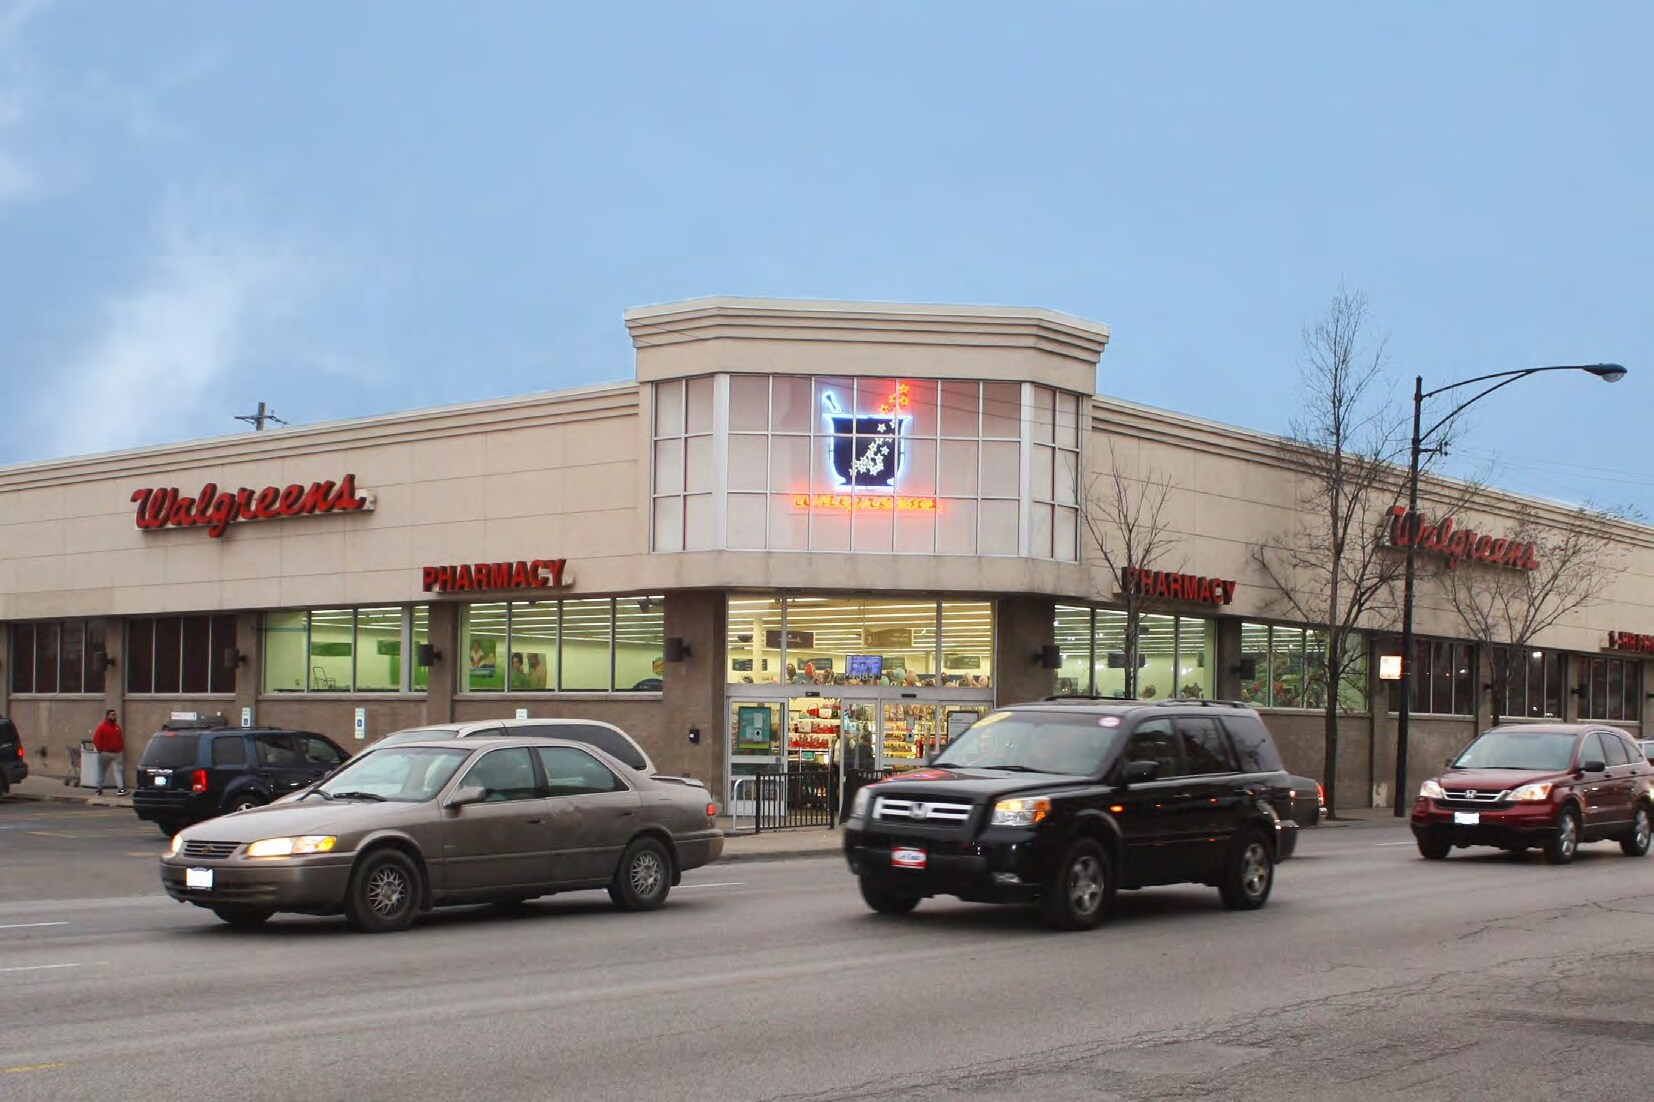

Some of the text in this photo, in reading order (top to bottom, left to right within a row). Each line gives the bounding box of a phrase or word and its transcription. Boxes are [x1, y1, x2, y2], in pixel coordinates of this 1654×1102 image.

[130, 473, 367, 538] Walgreens
[1385, 505, 1540, 570] Walgreens
[422, 558, 567, 592] PHARMACY
[1121, 566, 1237, 605] PHARMACY
